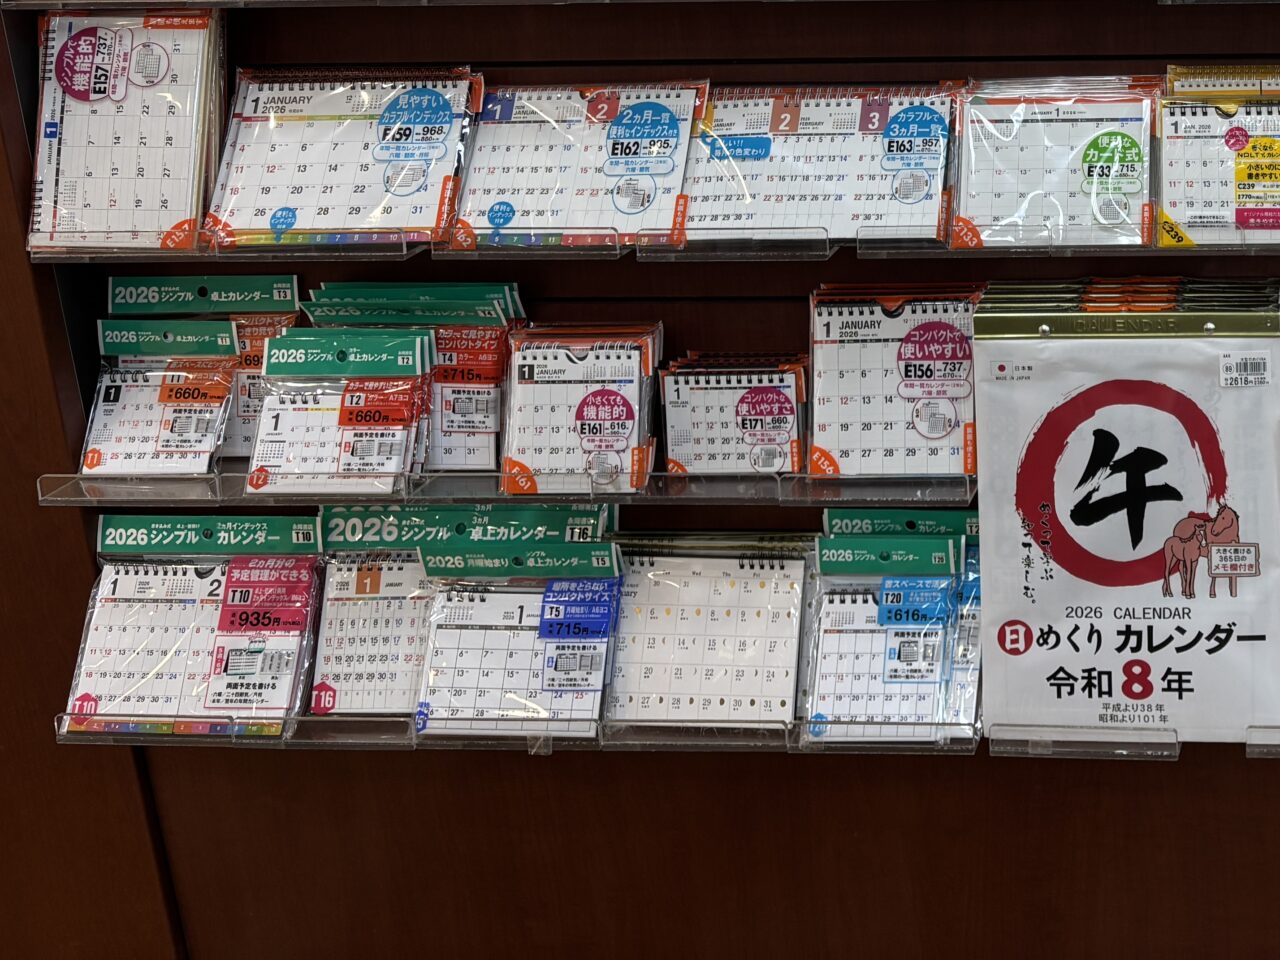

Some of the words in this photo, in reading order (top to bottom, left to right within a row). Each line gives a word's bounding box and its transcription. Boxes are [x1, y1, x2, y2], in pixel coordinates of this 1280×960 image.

[71, 35, 96, 92] 機能的
[92, 65, 108, 95] E157
[398, 95, 444, 109] 見やすい
[381, 109, 450, 123] カラフルインデックス
[897, 112, 940, 123] カラフルで
[611, 141, 640, 157] E162
[887, 140, 914, 154] E163
[1237, 182, 1256, 190] C239
[115, 286, 161, 304] 2026
[161, 291, 195, 302] シンプル
[211, 291, 270, 302] 卓上カレンダー
[277, 290, 288, 300] T3
[839, 320, 883, 330] JANUARY
[1074, 318, 1179, 333] CALENDAR
[910, 330, 961, 342] コンパクトで
[438, 340, 499, 350] コンパクトタイプ
[900, 342, 970, 359] 使いやすい
[904, 363, 934, 379] E156
[583, 405, 628, 420] 機能的
[737, 403, 794, 416] 使いやすさ
[580, 421, 602, 435] E161
[741, 417, 765, 431] E171
[328, 518, 400, 542] 2026
[401, 527, 451, 541] シンプル
[470, 526, 560, 541] 卓上カレンダー
[568, 526, 589, 541] T16
[105, 529, 148, 546] 2026
[150, 531, 200, 545] シンプル
[217, 531, 281, 545] カレンダー
[294, 532, 313, 543] T10
[822, 550, 853, 562] 2026
[854, 552, 876, 562] シンプル
[892, 552, 919, 562] カレンダー
[230, 569, 310, 582] 予定管理ができる
[1213, 564, 1256, 573] メモ欄付き
[544, 591, 610, 601] コンパクトサイズ
[1065, 606, 1103, 620] 2026
[1113, 607, 1192, 620] CALENDAR
[225, 682, 278, 690] 両面予定を書ける
[1046, 659, 1195, 701] 令和8年
[311, 690, 335, 708] T16
